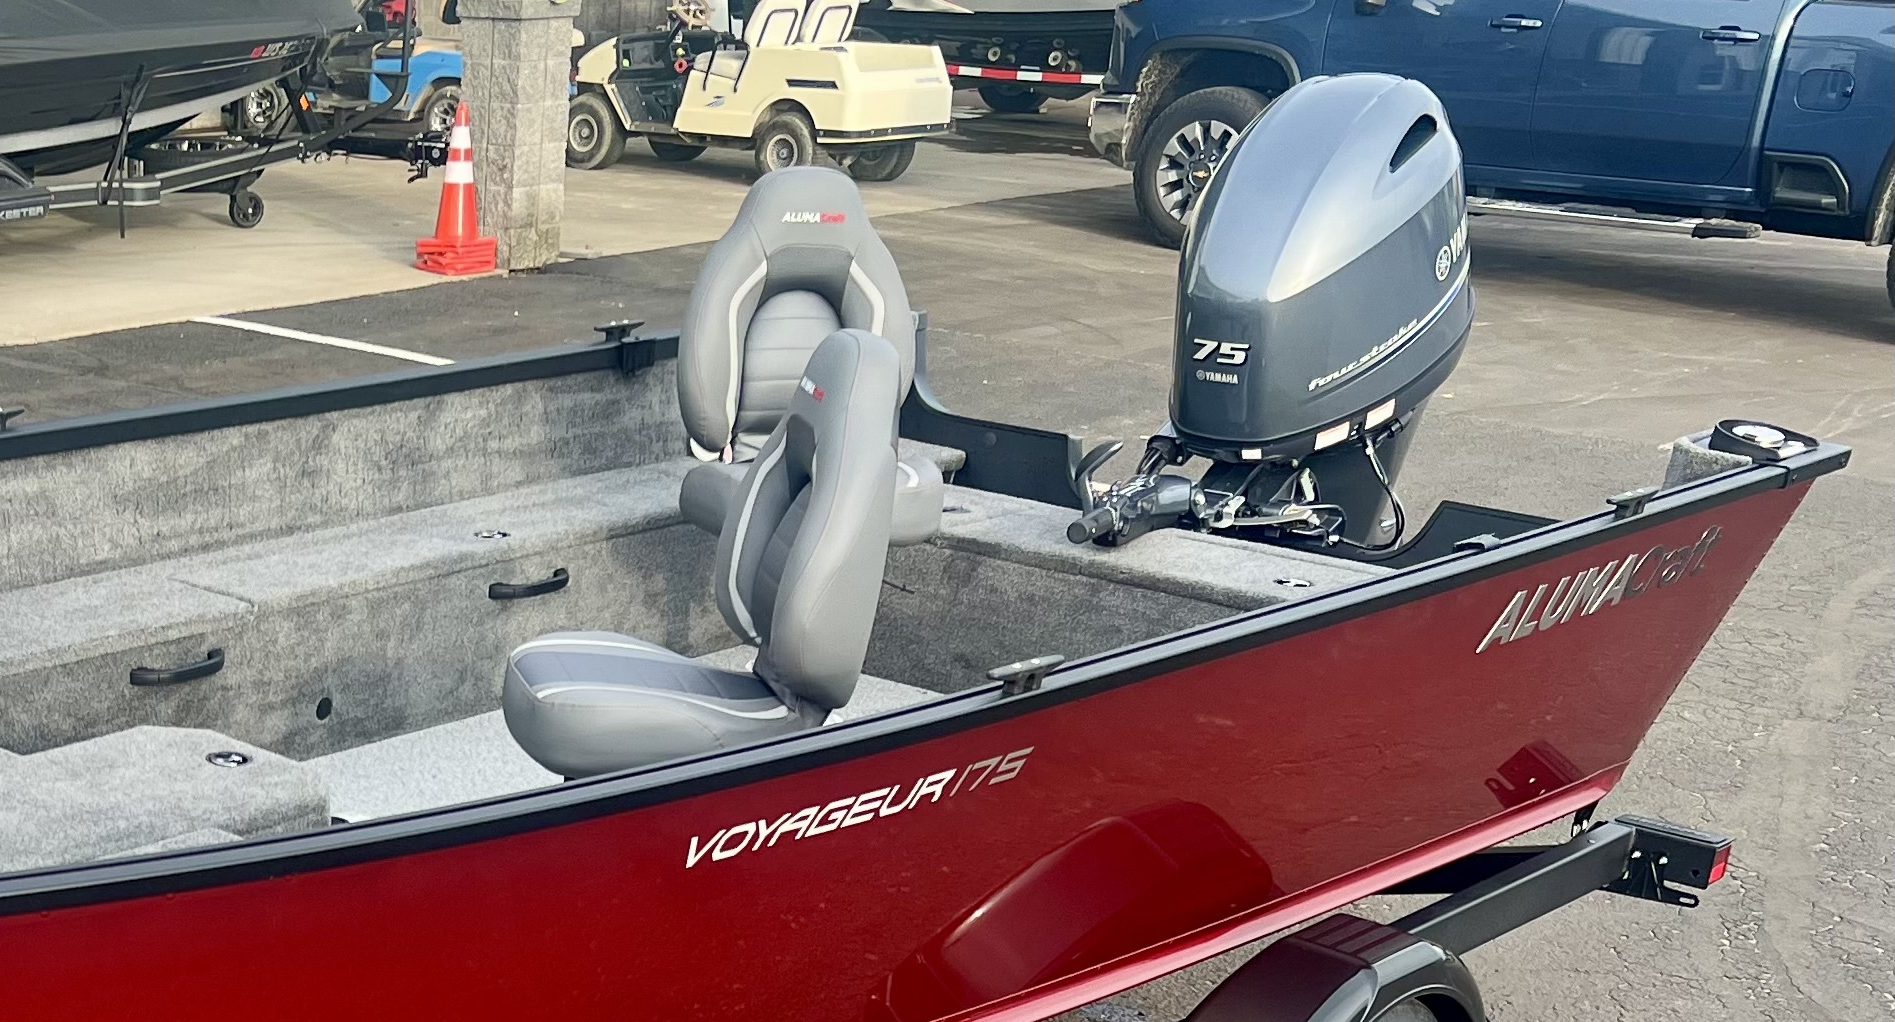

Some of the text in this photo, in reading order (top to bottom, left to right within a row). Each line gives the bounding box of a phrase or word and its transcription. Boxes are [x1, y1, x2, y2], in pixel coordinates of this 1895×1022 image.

[1192, 338, 1250, 365] 75
[1205, 371, 1239, 384] YAMAHA
[685, 746, 1035, 869] VOYAGEUR 175
